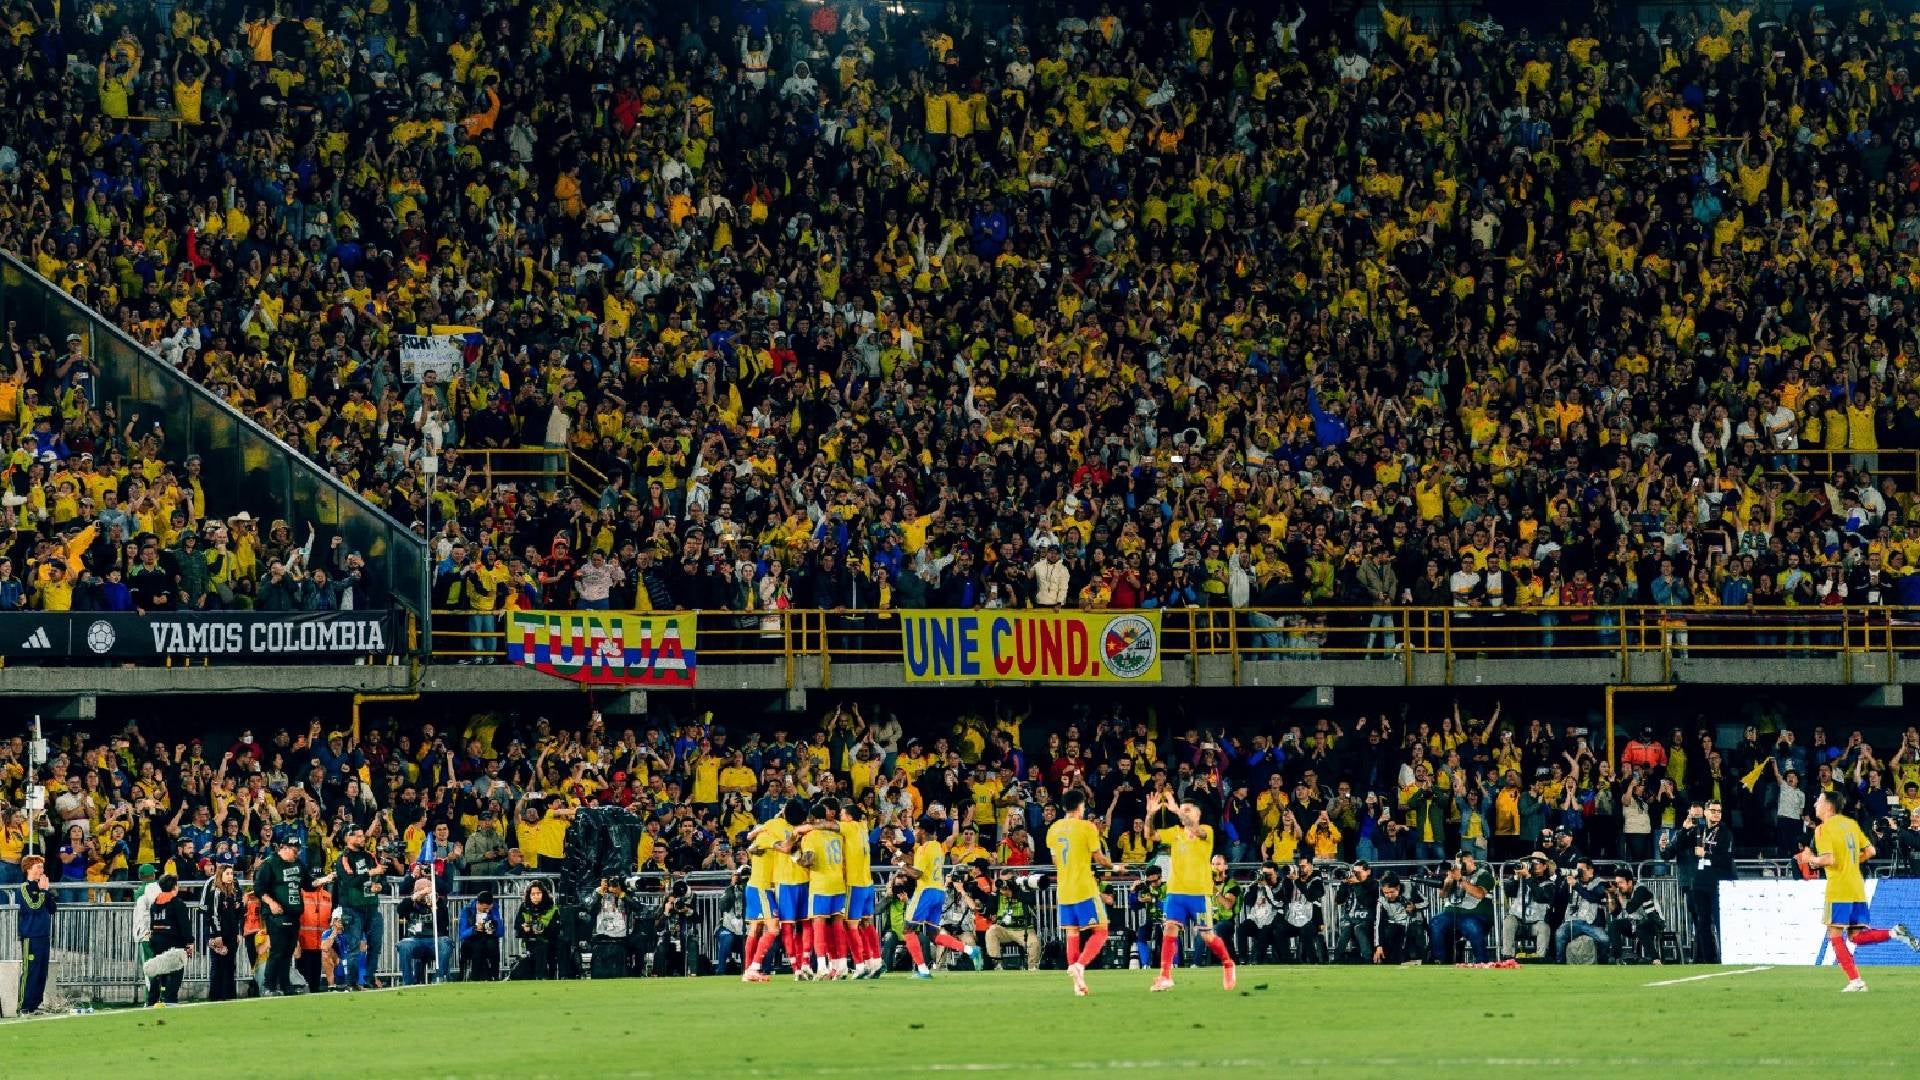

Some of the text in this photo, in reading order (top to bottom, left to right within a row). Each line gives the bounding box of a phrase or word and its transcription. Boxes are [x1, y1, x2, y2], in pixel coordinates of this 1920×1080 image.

[150, 621, 385, 652] VAMOS COLOMBIA
[514, 612, 689, 679] TUNJA
[904, 616, 1099, 676] UNE CUND.
[825, 839, 842, 864] 18
[1057, 837, 1069, 865] 7
[1845, 832, 1858, 864] 4
